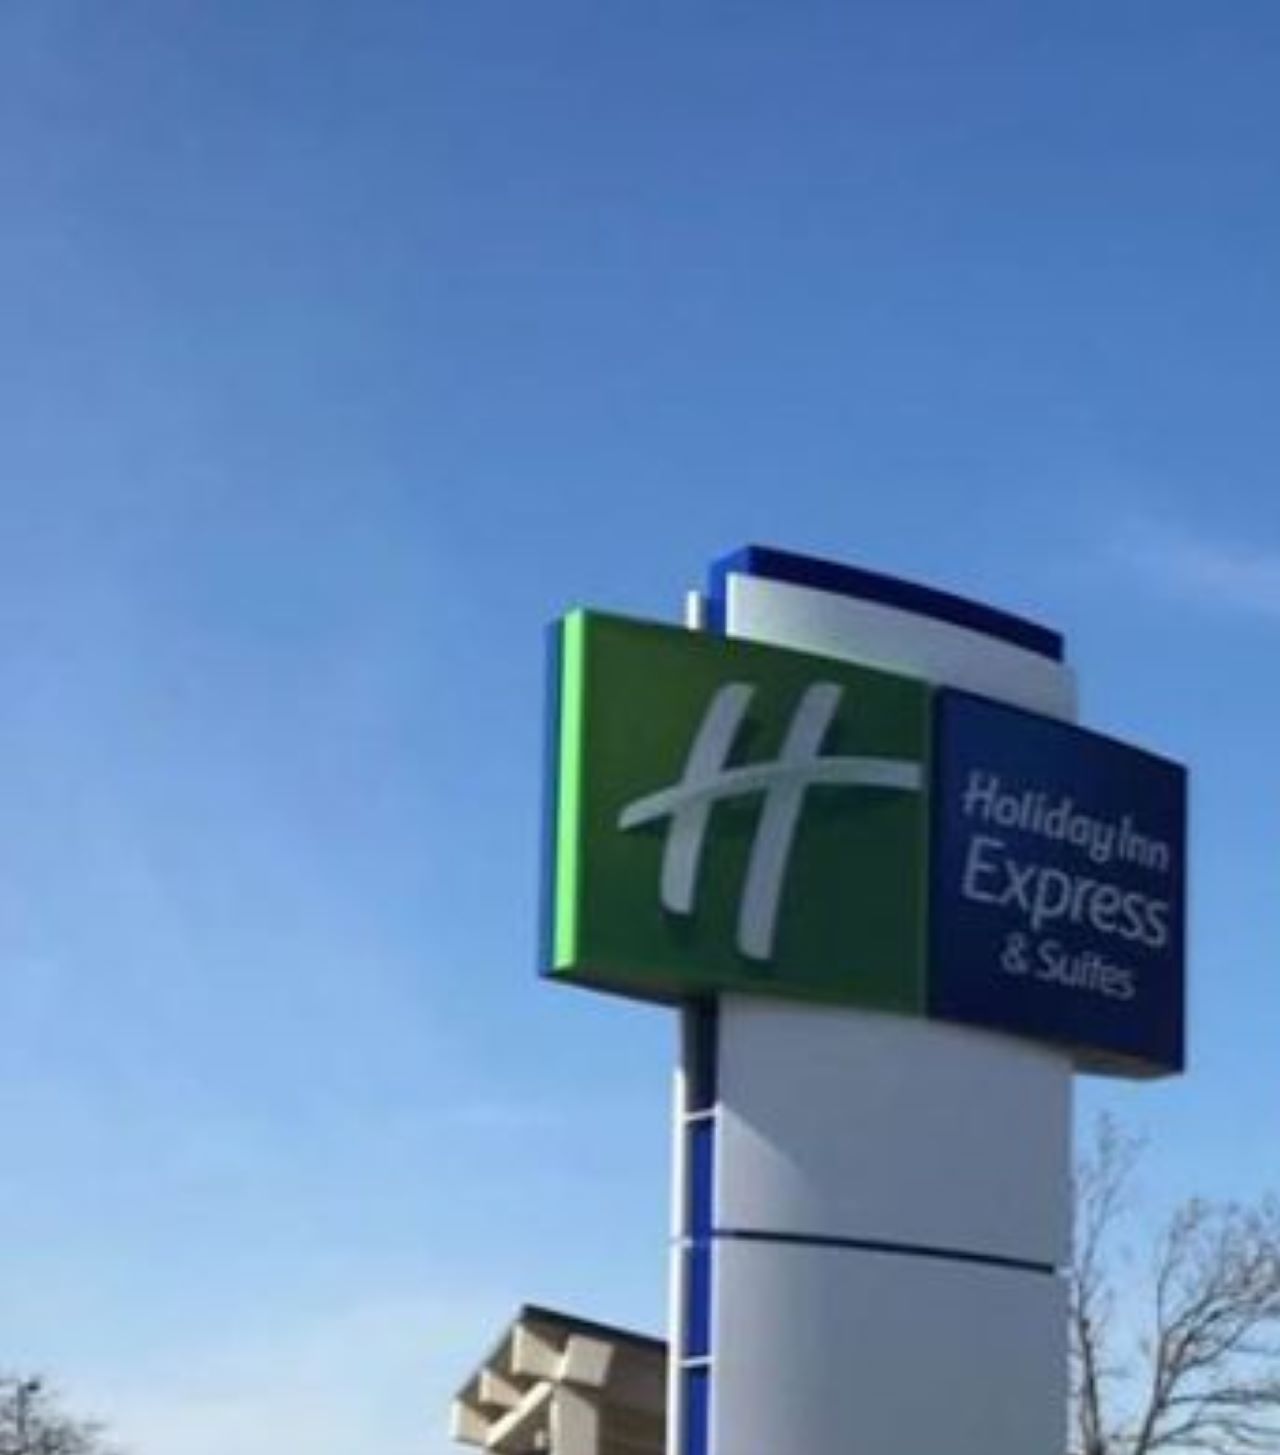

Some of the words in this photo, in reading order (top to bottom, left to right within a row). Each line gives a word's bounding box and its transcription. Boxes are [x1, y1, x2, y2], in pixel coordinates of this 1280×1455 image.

[962, 769, 1116, 863] Holiday
[1118, 813, 1171, 873] Inn
[962, 834, 1171, 948] Express
[1001, 931, 1030, 974] &
[1033, 938, 1137, 1000] Suites
